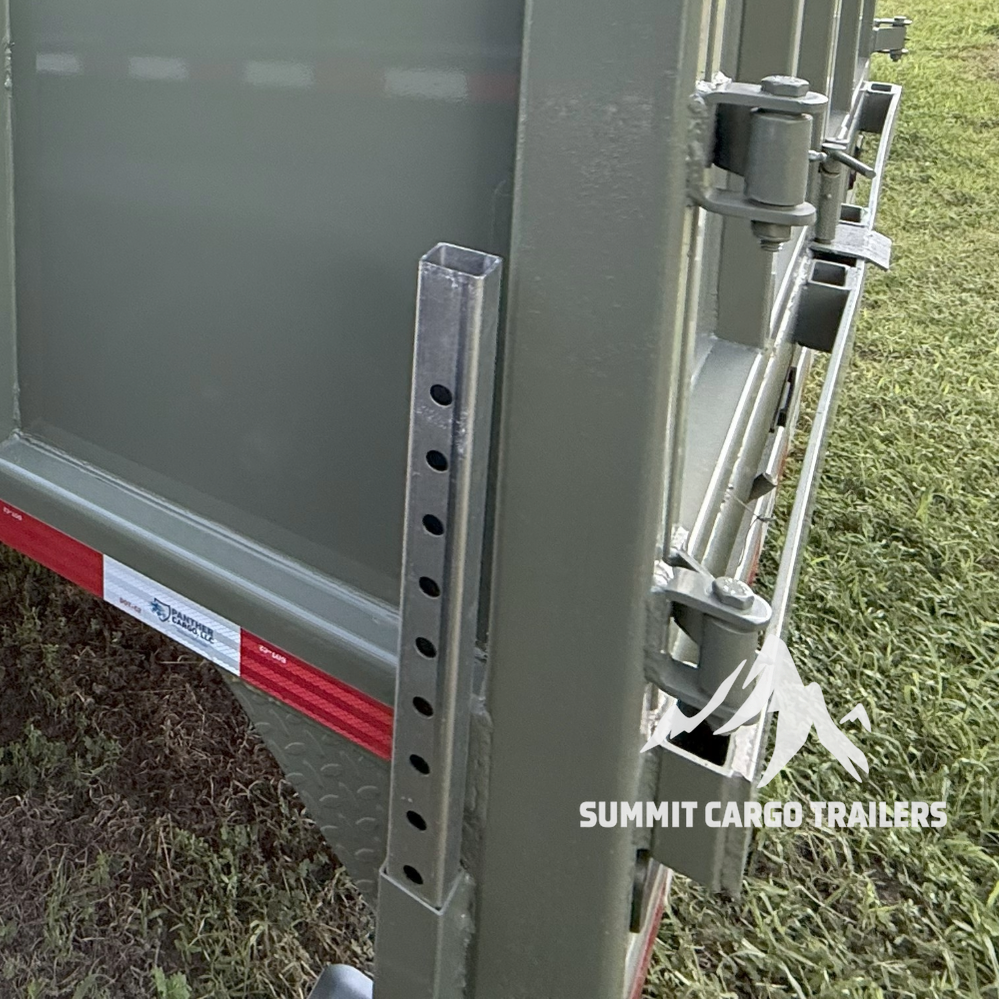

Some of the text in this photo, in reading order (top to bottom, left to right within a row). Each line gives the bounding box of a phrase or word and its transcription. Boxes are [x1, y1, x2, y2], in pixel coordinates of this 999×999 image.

[171, 608, 214, 638] PANTHER
[172, 616, 199, 637] CARGO,
[200, 630, 215, 644] LLC
